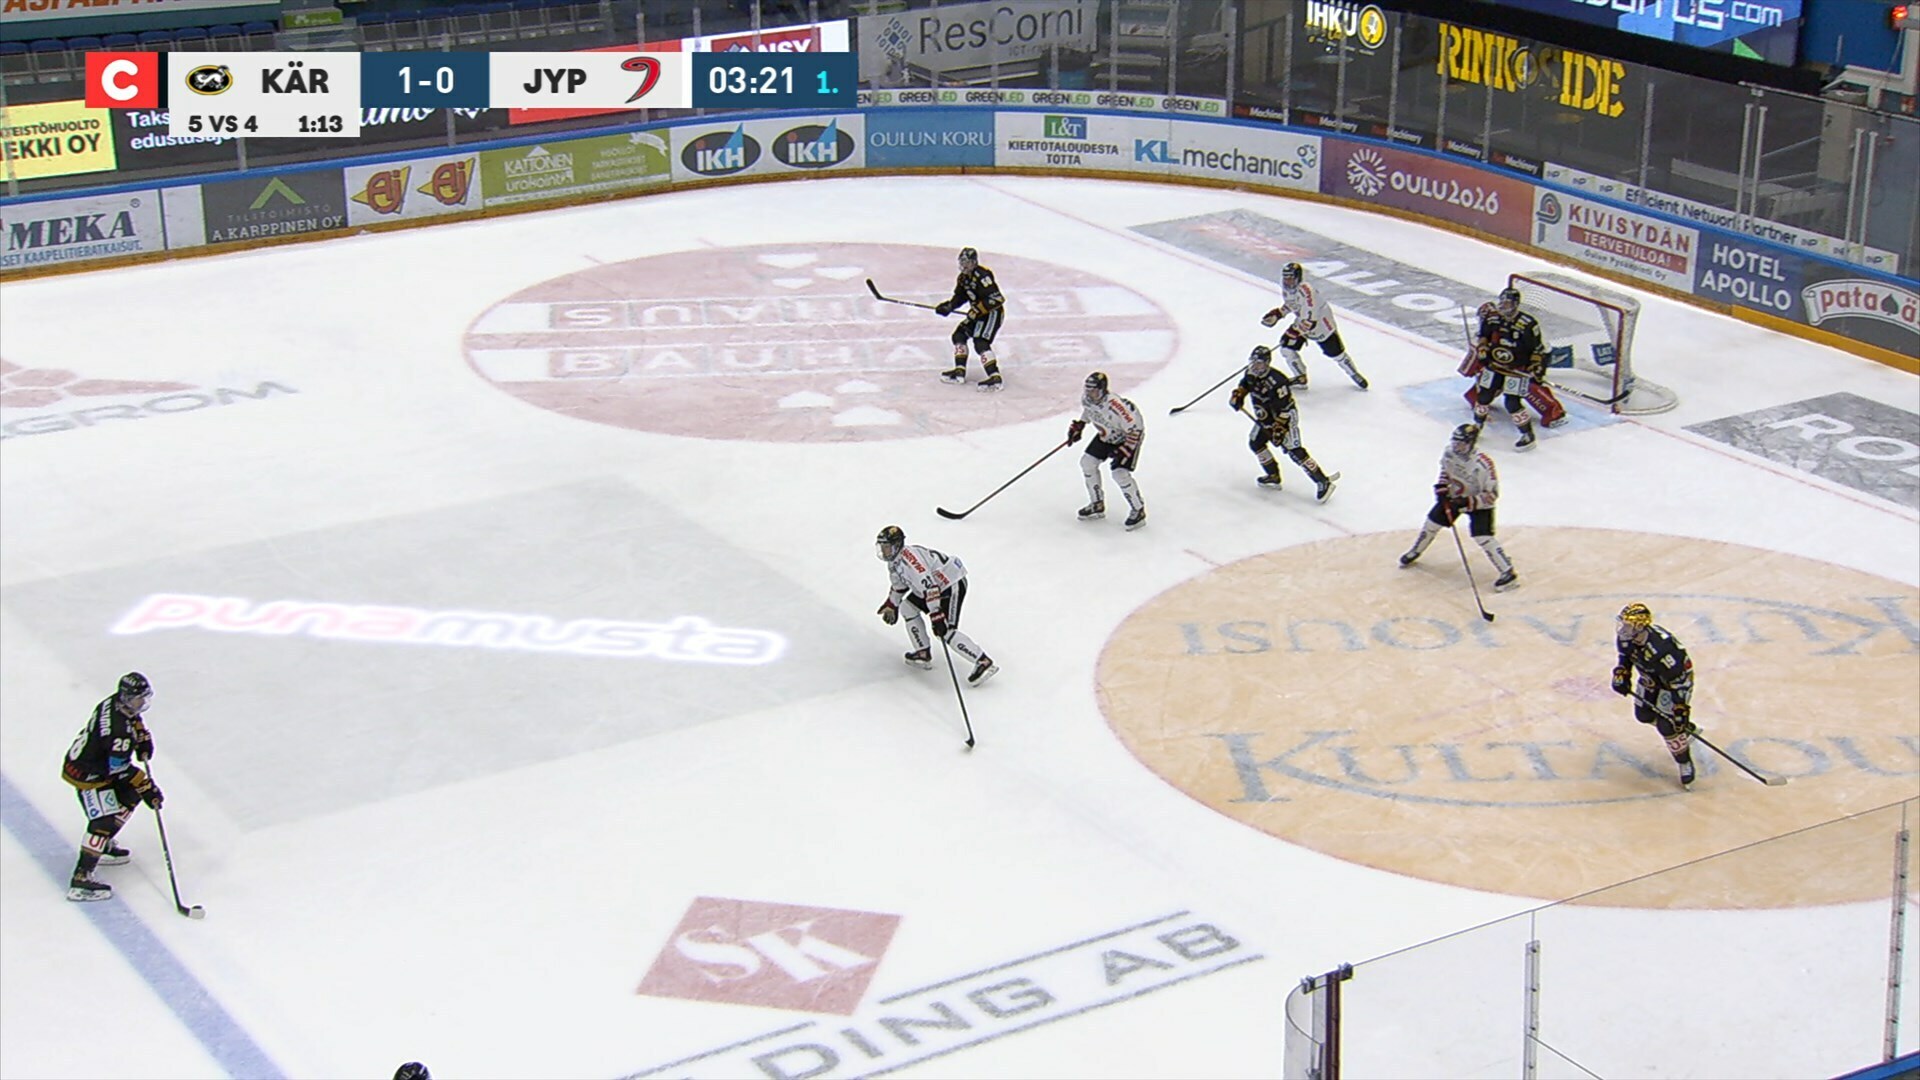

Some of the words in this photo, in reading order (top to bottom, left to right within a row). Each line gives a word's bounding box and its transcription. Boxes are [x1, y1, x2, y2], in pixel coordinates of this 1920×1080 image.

[67, 132, 102, 152] OY
[870, 131, 938, 148] OULUN
[942, 129, 993, 147] KORU
[1050, 117, 1082, 137] L&T
[1008, 140, 1119, 155] KIERTOTALOUDESTA
[1046, 153, 1081, 165] TOTTA
[1134, 139, 1180, 164] KL
[1182, 147, 1303, 181] mechanics
[1390, 171, 1499, 216] OULU2026
[8, 211, 136, 251] MEKA
[322, 215, 344, 229] OY
[1569, 203, 1690, 252] KIVISYDÄN
[1713, 243, 1786, 282] HOTEL
[1701, 270, 1792, 311] APOLLO
[1820, 287, 1877, 313] pata
[116, 596, 780, 663] punamusta
[1659, 654, 1677, 670] 19
[112, 737, 131, 752] 26
[675, 924, 880, 983] SK
[1098, 922, 1241, 986] AB
